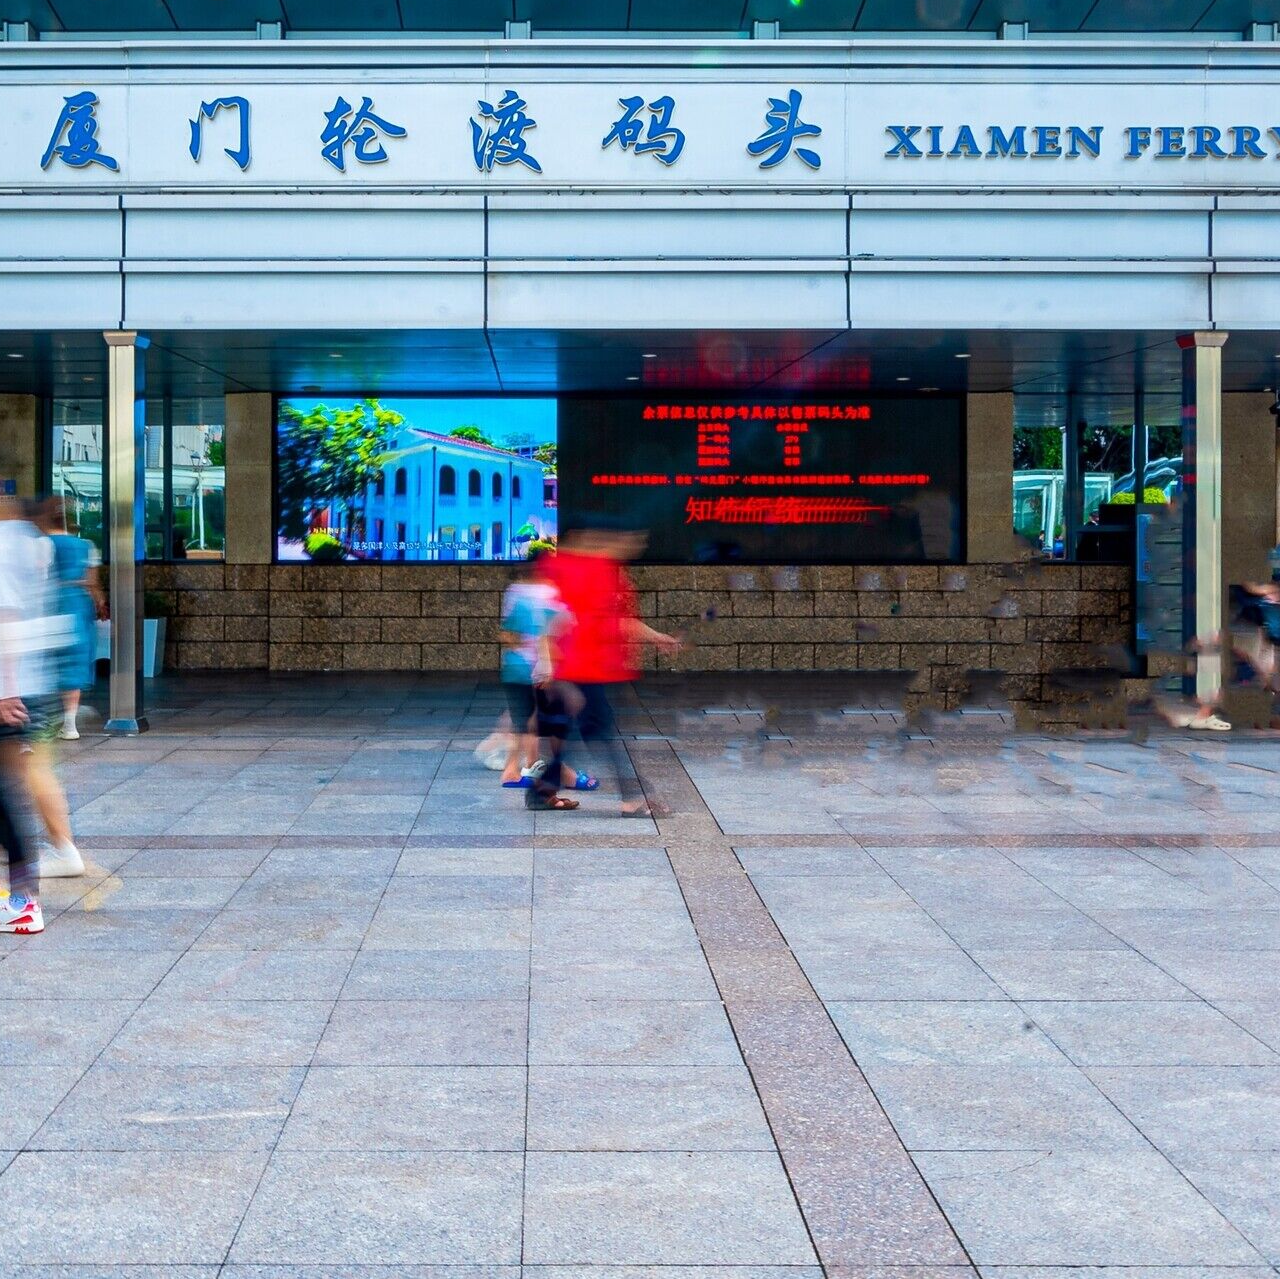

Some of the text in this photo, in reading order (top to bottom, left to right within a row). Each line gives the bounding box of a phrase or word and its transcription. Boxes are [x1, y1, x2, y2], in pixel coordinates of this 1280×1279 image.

[40, 88, 823, 174] 厦门轮渡码头
[884, 124, 1105, 159] XIAMEN
